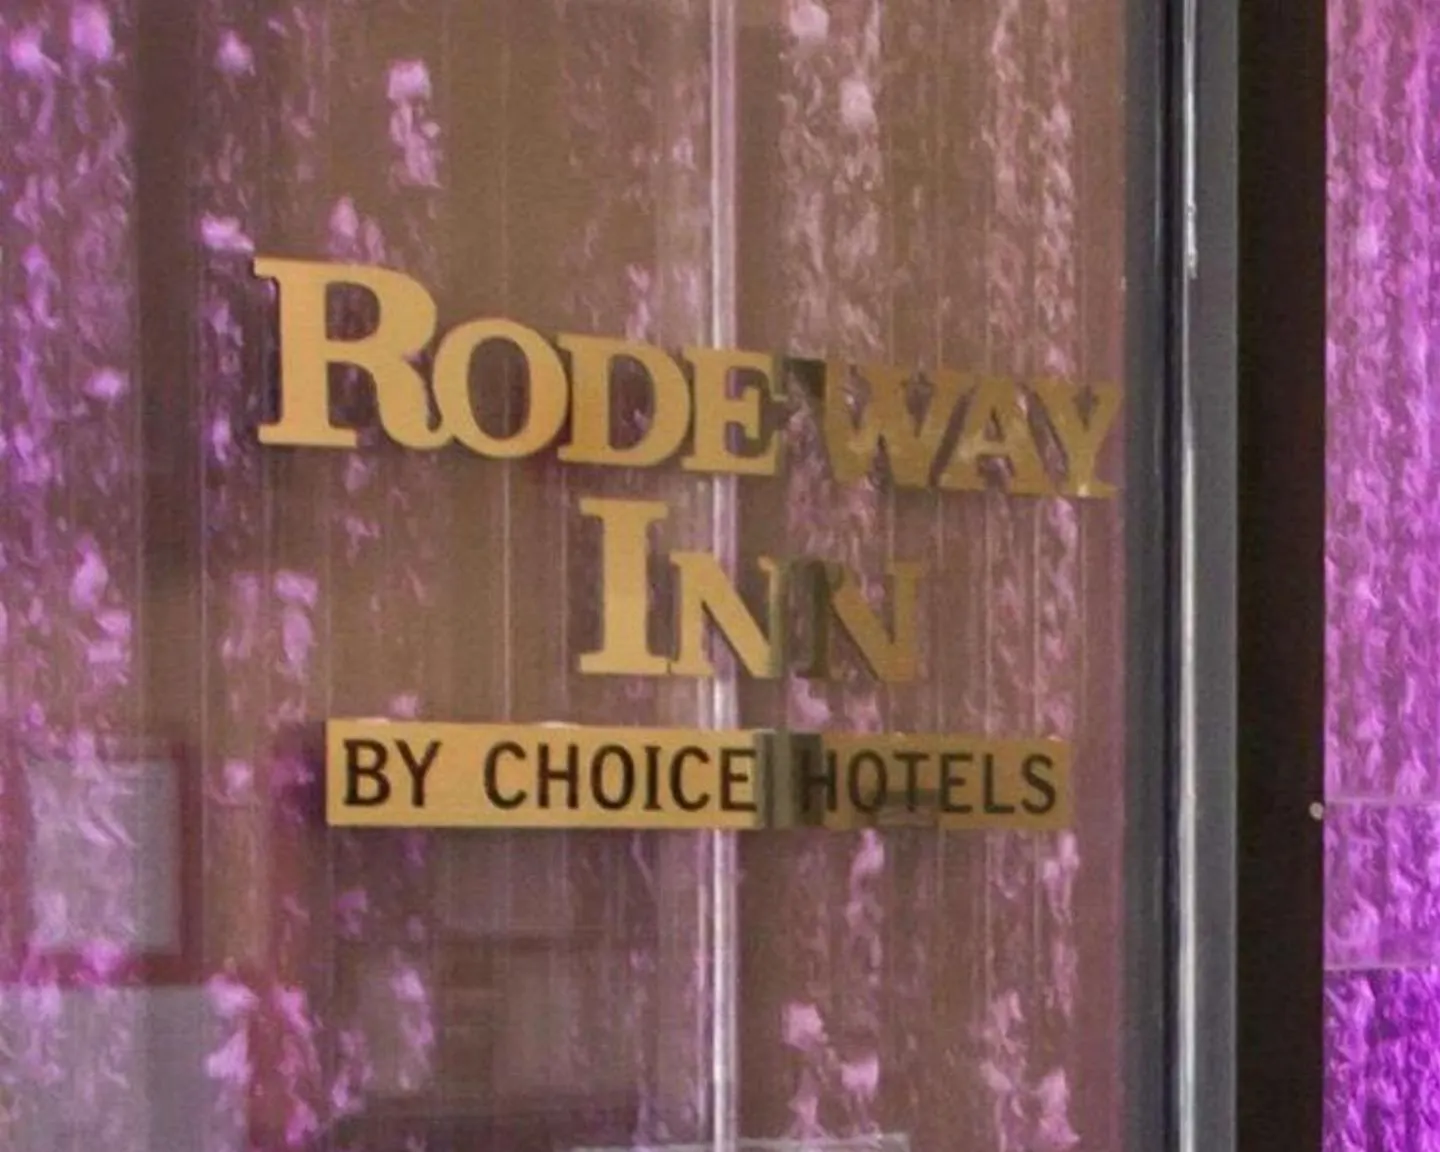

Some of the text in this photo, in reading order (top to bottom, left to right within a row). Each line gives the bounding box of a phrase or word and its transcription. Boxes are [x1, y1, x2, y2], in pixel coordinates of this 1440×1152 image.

[254, 256, 1120, 498] RODEWAY
[578, 497, 923, 682] INN
[342, 738, 1057, 815] BY CHOICE HOTELS
